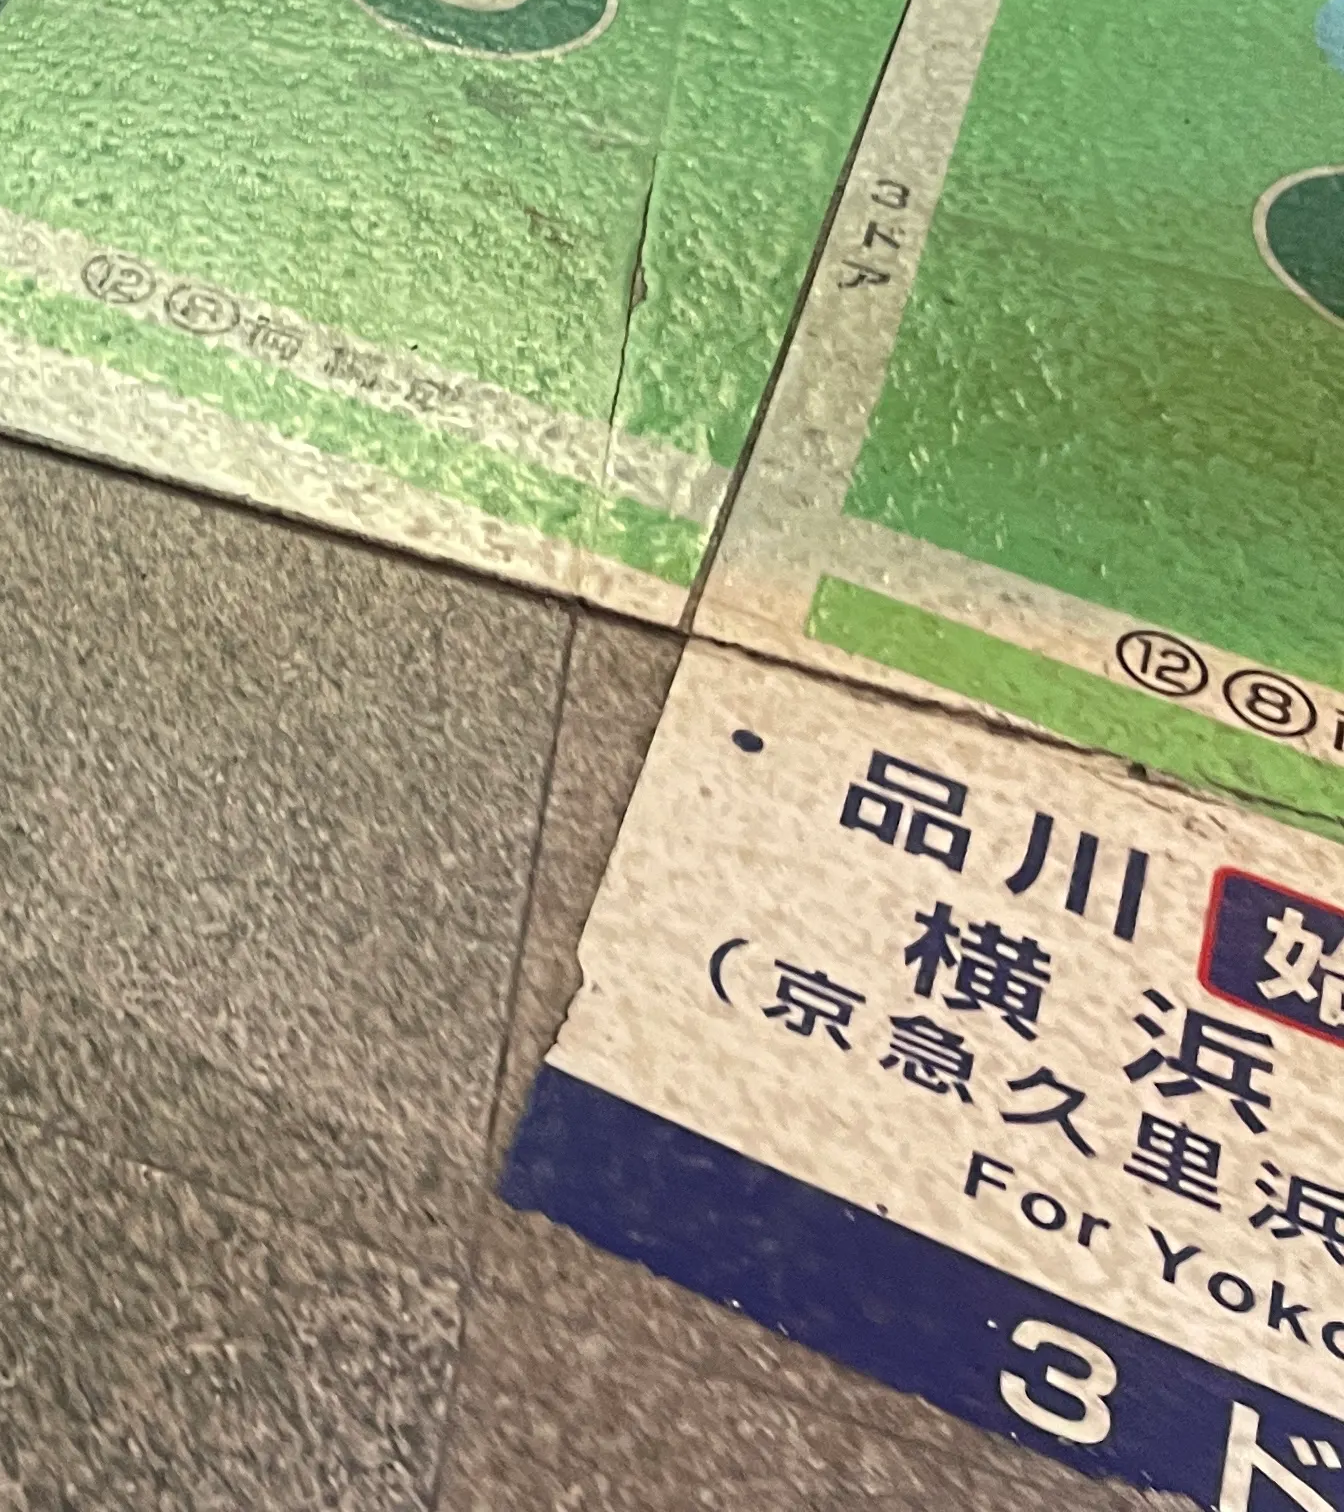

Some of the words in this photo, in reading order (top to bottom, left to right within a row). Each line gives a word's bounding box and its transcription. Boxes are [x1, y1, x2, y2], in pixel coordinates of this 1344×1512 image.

[1115, 629, 1344, 752] ⑫⑧
[902, 899, 1275, 1135] 横浜
[964, 1149, 1112, 1248] For
